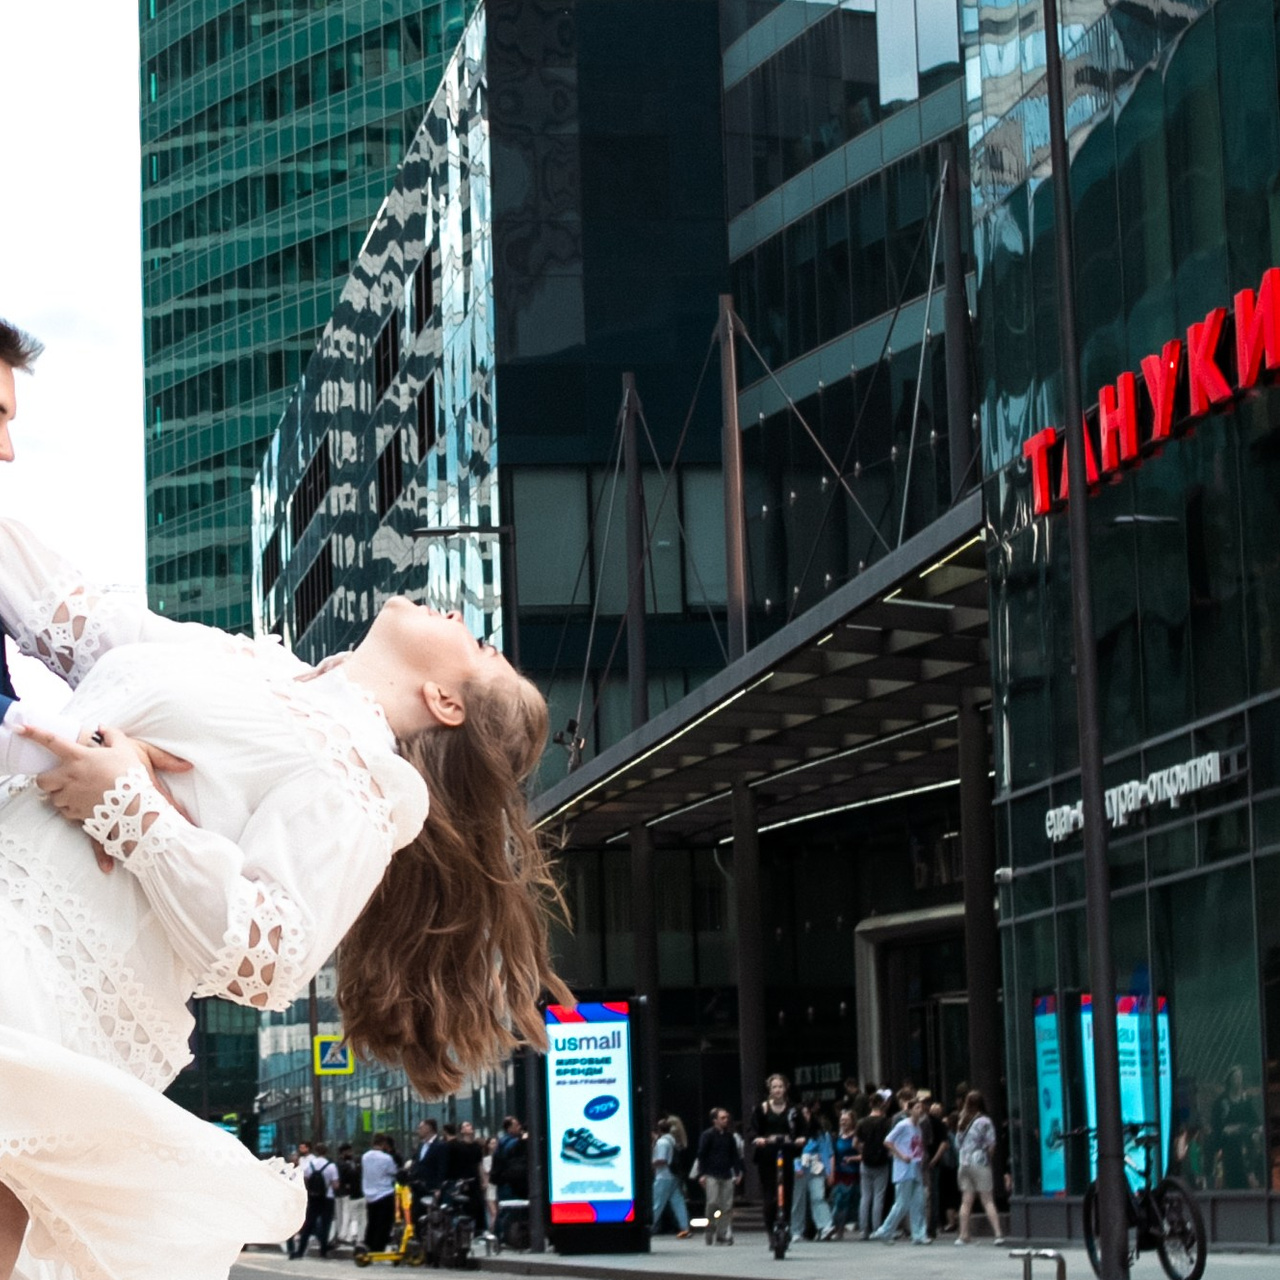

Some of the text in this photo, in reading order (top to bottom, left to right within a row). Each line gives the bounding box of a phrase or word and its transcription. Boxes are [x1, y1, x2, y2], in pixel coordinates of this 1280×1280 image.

[554, 1030, 622, 1052] usmall
[555, 1056, 612, 1066] МИРОВЫЕ
[555, 1066, 604, 1077] БРЕНДЫ
